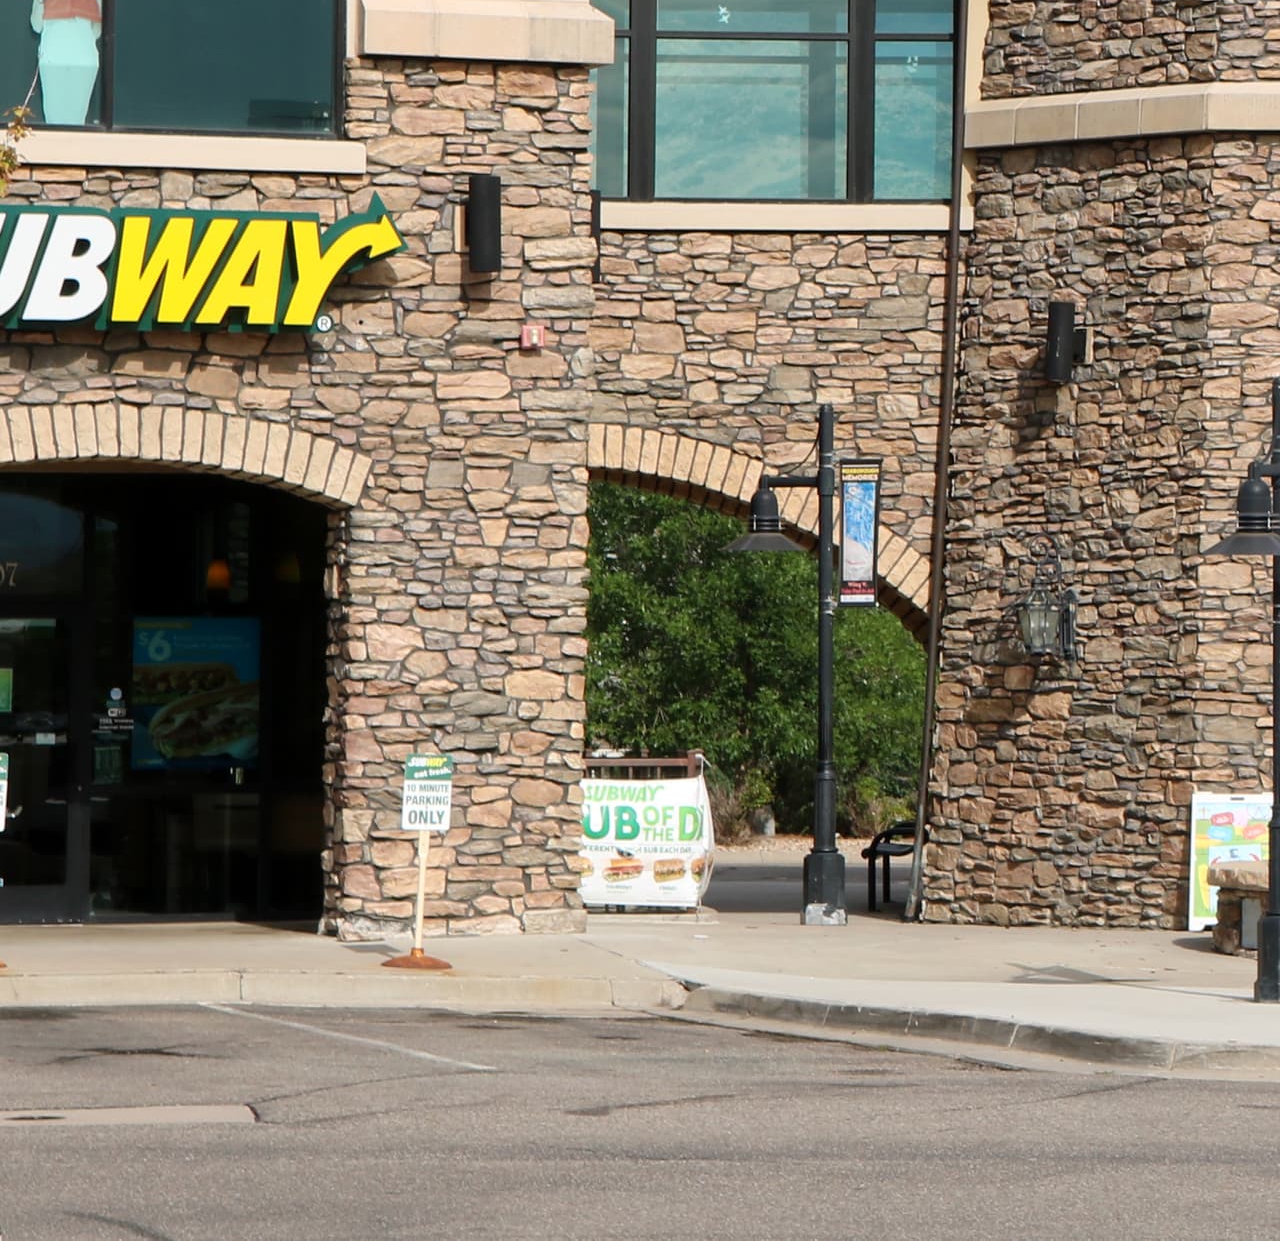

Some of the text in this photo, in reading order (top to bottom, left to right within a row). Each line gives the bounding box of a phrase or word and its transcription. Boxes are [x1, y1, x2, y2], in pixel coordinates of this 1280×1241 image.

[0, 212, 402, 326] UBWAY
[408, 756, 448, 767] SUBWAY
[407, 783, 449, 793] 10 MINUTE
[584, 784, 664, 803] SUBWAY
[406, 795, 449, 806] PARKING
[408, 809, 445, 825] ONLY
[582, 805, 640, 840] UB
[643, 805, 674, 826] OF
[642, 827, 675, 842] THE
